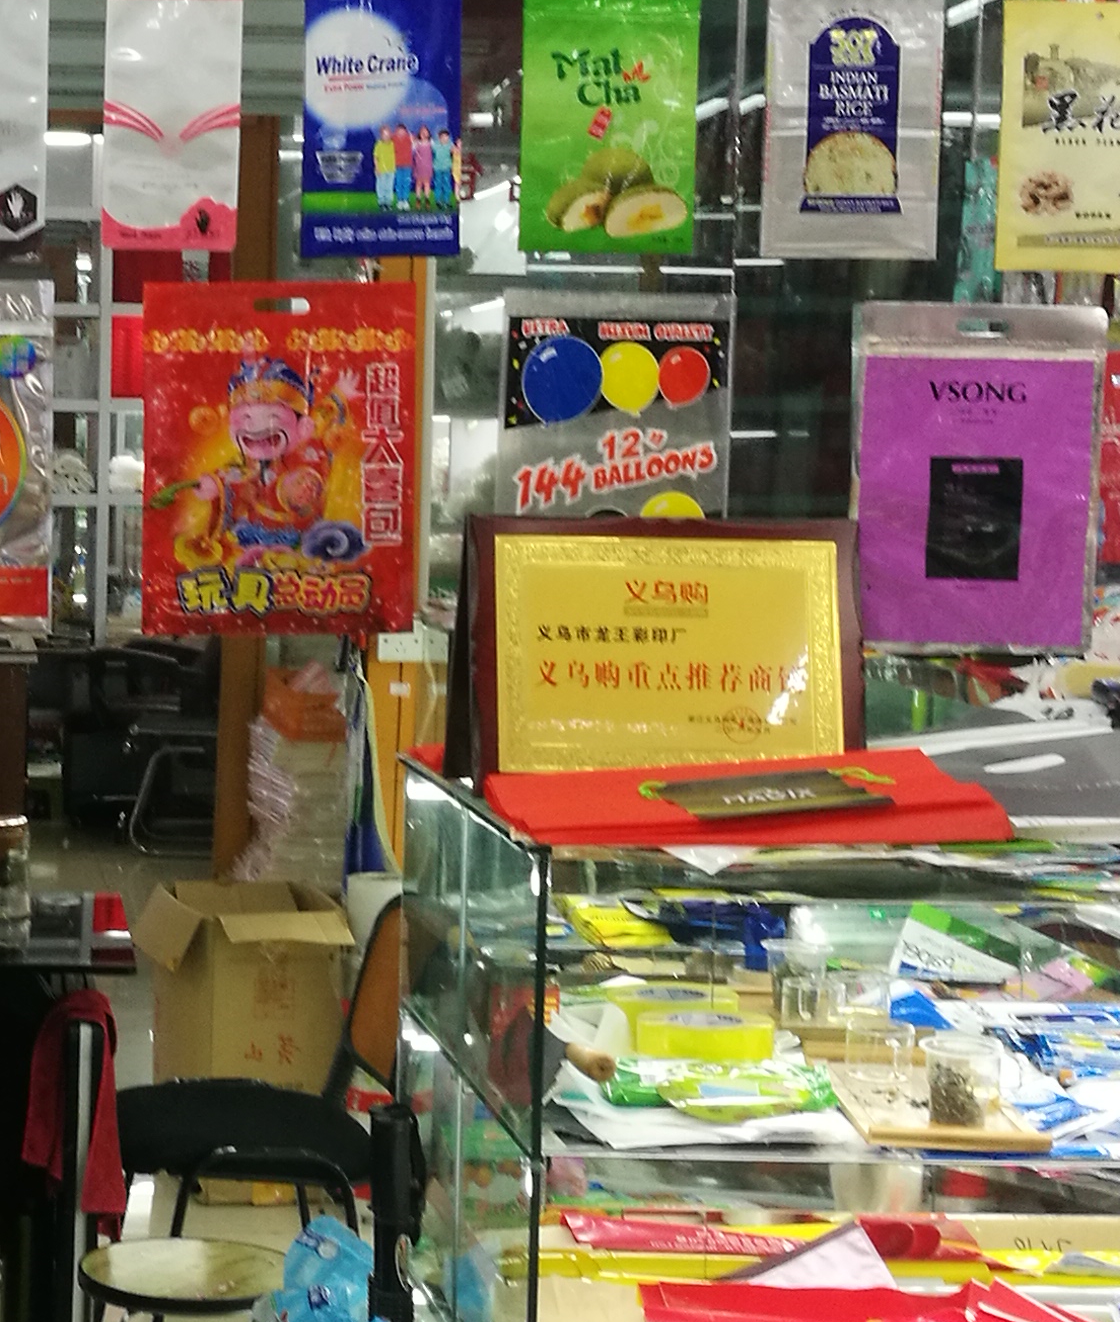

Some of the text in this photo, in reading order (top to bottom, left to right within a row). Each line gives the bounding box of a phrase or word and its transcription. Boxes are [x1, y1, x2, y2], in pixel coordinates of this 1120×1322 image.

[316, 53, 417, 75] White Crane
[551, 47, 622, 81] Mat
[830, 71, 878, 85] INDIAN
[577, 79, 642, 107] Cha
[818, 83, 889, 102] BASMATI
[834, 101, 873, 117] RICE
[521, 318, 570, 337] ULTRA
[654, 322, 715, 342] QUALITY
[929, 380, 1028, 404] VSONG
[514, 441, 718, 515] 144 BALLOONS
[625, 579, 709, 605] 义乌购
